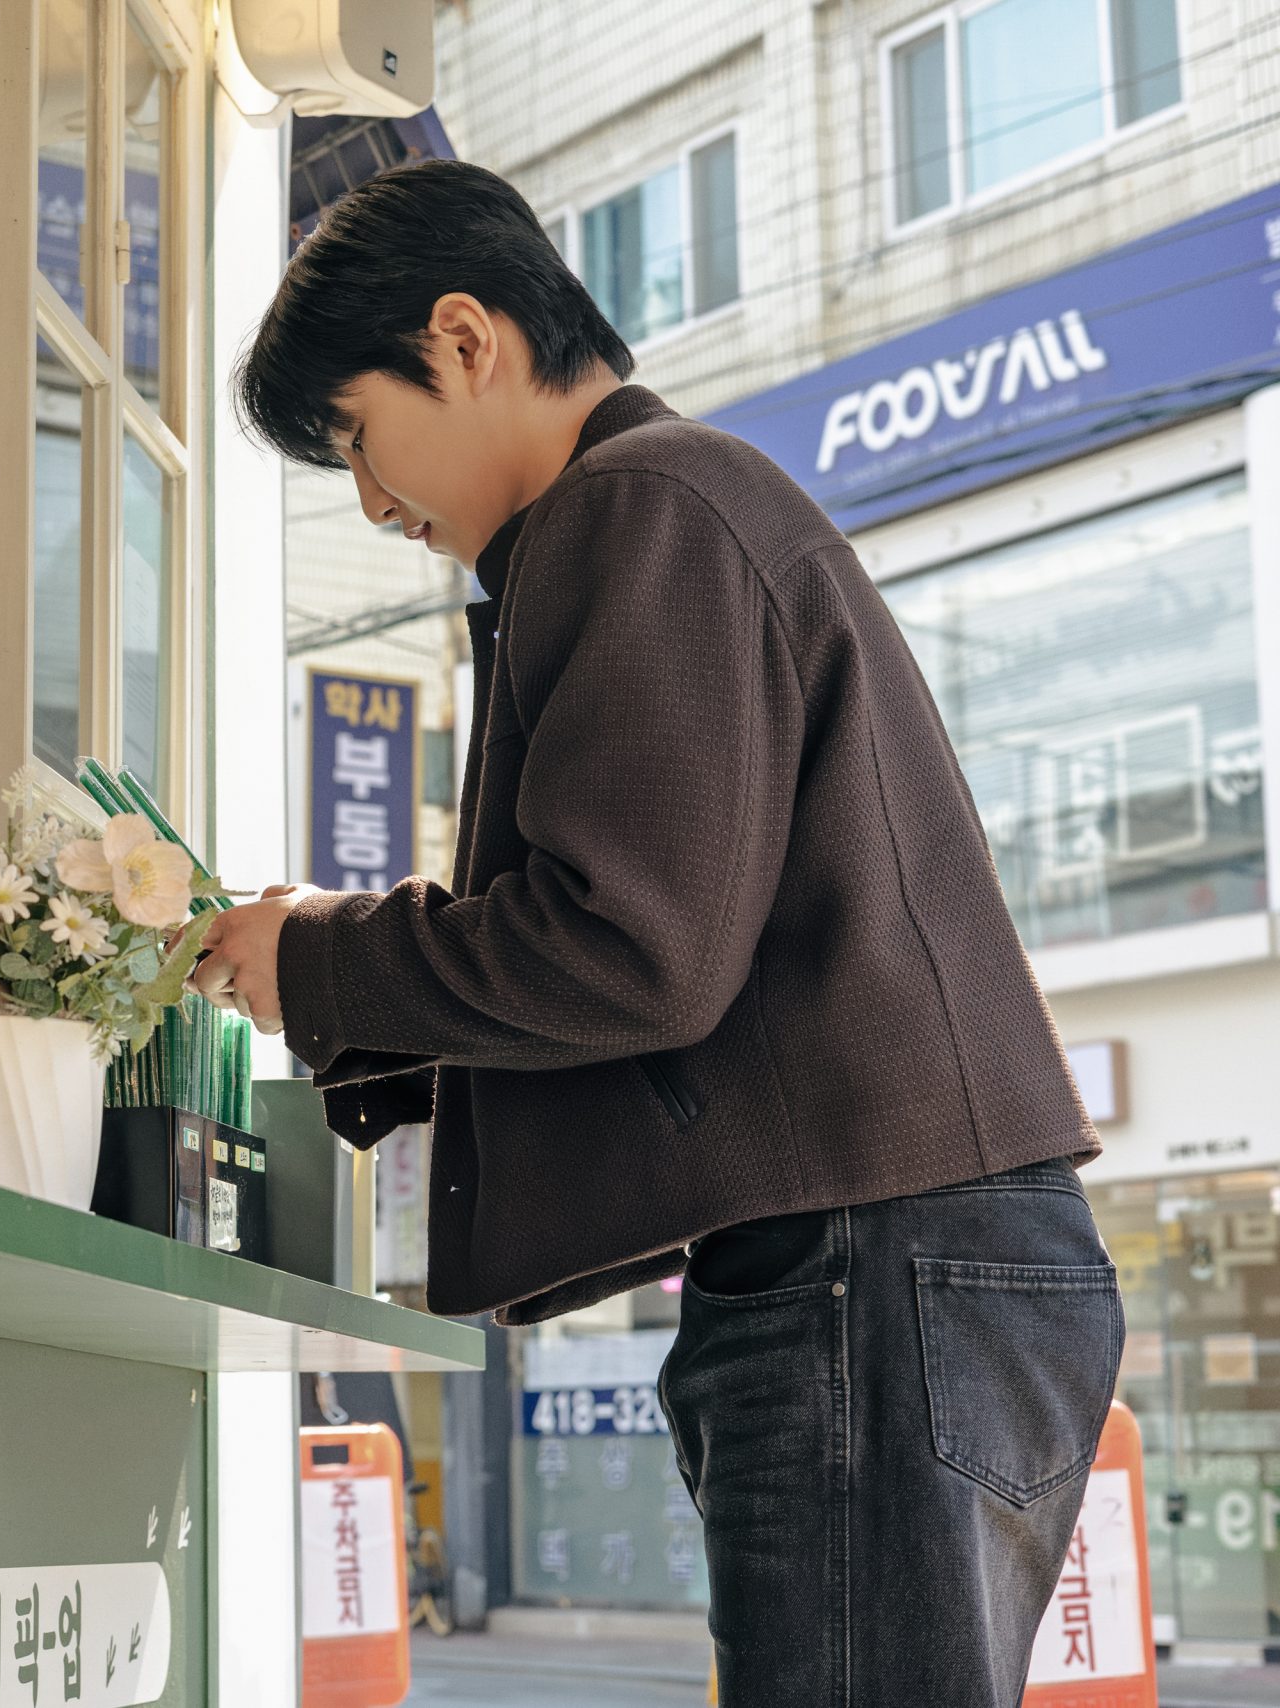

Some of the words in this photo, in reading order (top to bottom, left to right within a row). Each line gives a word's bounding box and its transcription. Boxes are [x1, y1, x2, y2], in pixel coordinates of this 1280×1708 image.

[531, 1387, 670, 1434] 418-32
[331, 1481, 364, 1627] 주차금지
[1058, 1502, 1097, 1672] 차금지
